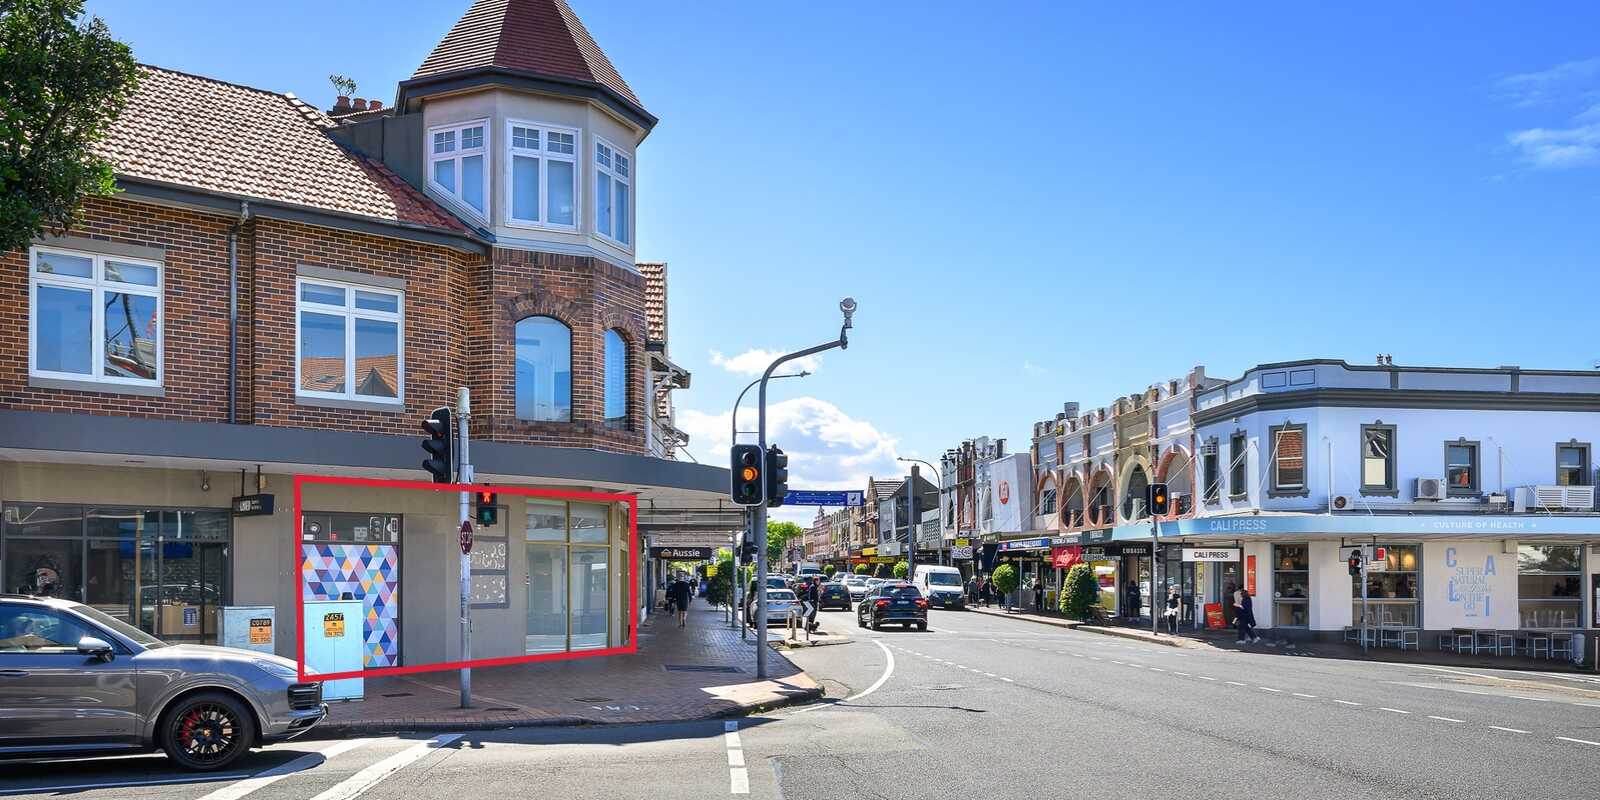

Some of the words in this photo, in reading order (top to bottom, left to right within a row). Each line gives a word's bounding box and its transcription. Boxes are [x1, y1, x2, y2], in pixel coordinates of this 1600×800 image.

[1210, 520, 1231, 531] CALI
[1232, 519, 1267, 530] PRESS
[1433, 519, 1473, 529] CULTURE
[1475, 519, 1488, 528] OF
[1490, 519, 1524, 529] HEALTH
[672, 549, 701, 557] Aussie
[1193, 551, 1208, 559] CALI
[1208, 551, 1229, 559] PRESS
